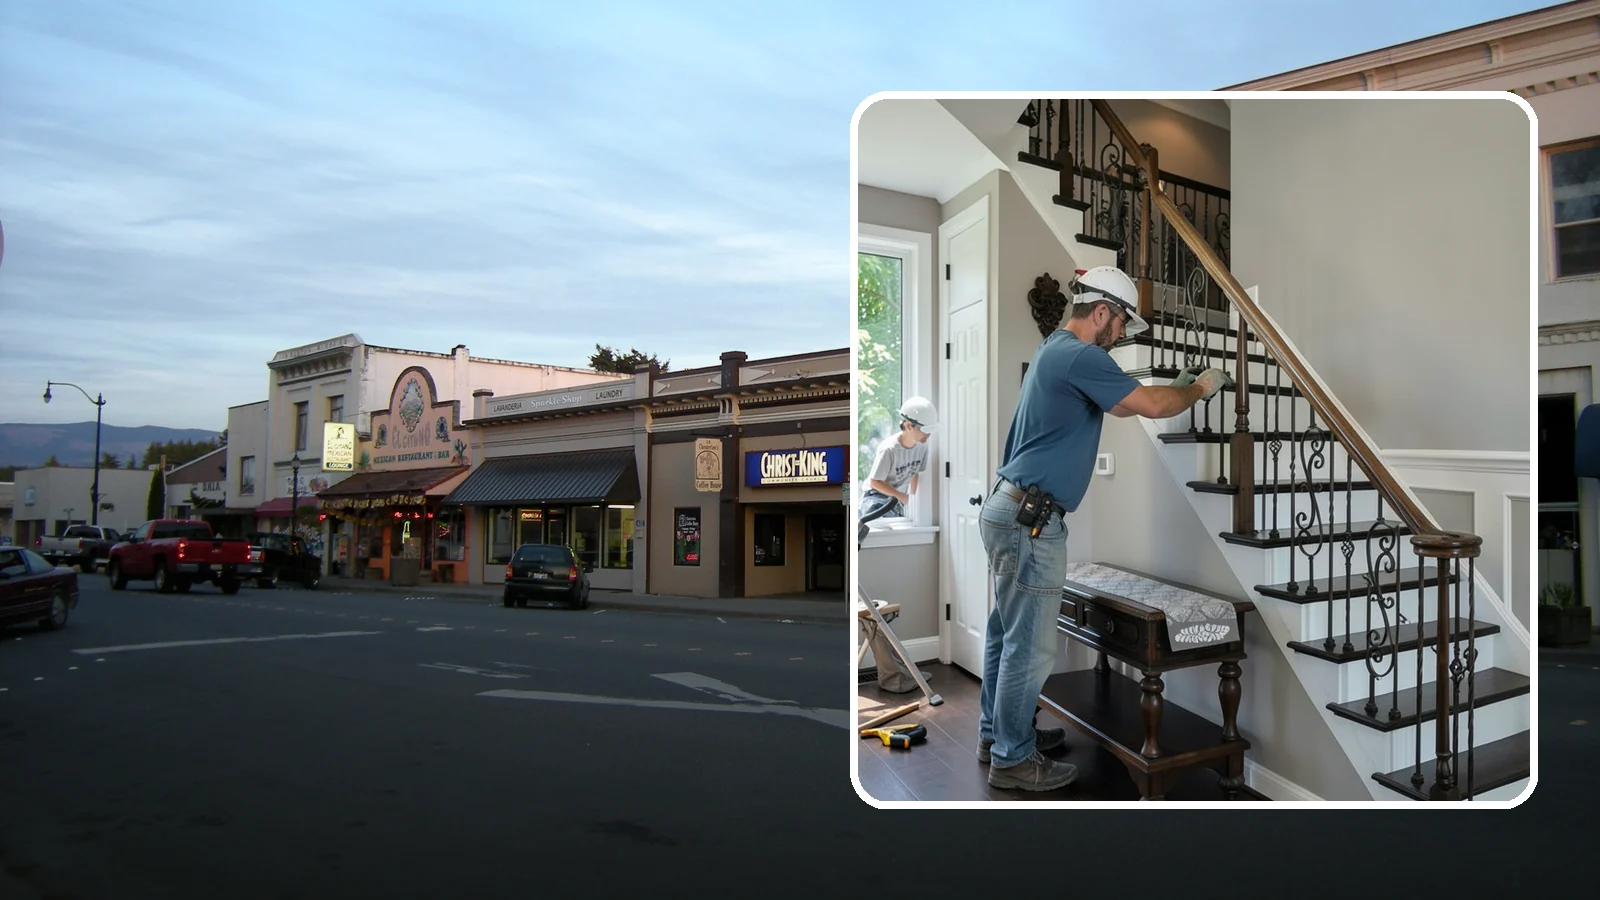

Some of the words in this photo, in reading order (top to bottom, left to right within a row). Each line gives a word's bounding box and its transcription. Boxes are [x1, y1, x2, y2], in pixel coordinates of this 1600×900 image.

[494, 402, 522, 413] LAVANDERIA
[531, 397, 560, 409] Sparkle
[561, 394, 583, 405] Shop
[595, 389, 624, 400] LAUNDRY
[373, 455, 396, 464] MEXICAN
[397, 452, 433, 462] RESTAURANT
[438, 450, 450, 459] BAR
[761, 452, 797, 477] CHRIST
[799, 450, 827, 476] KING
